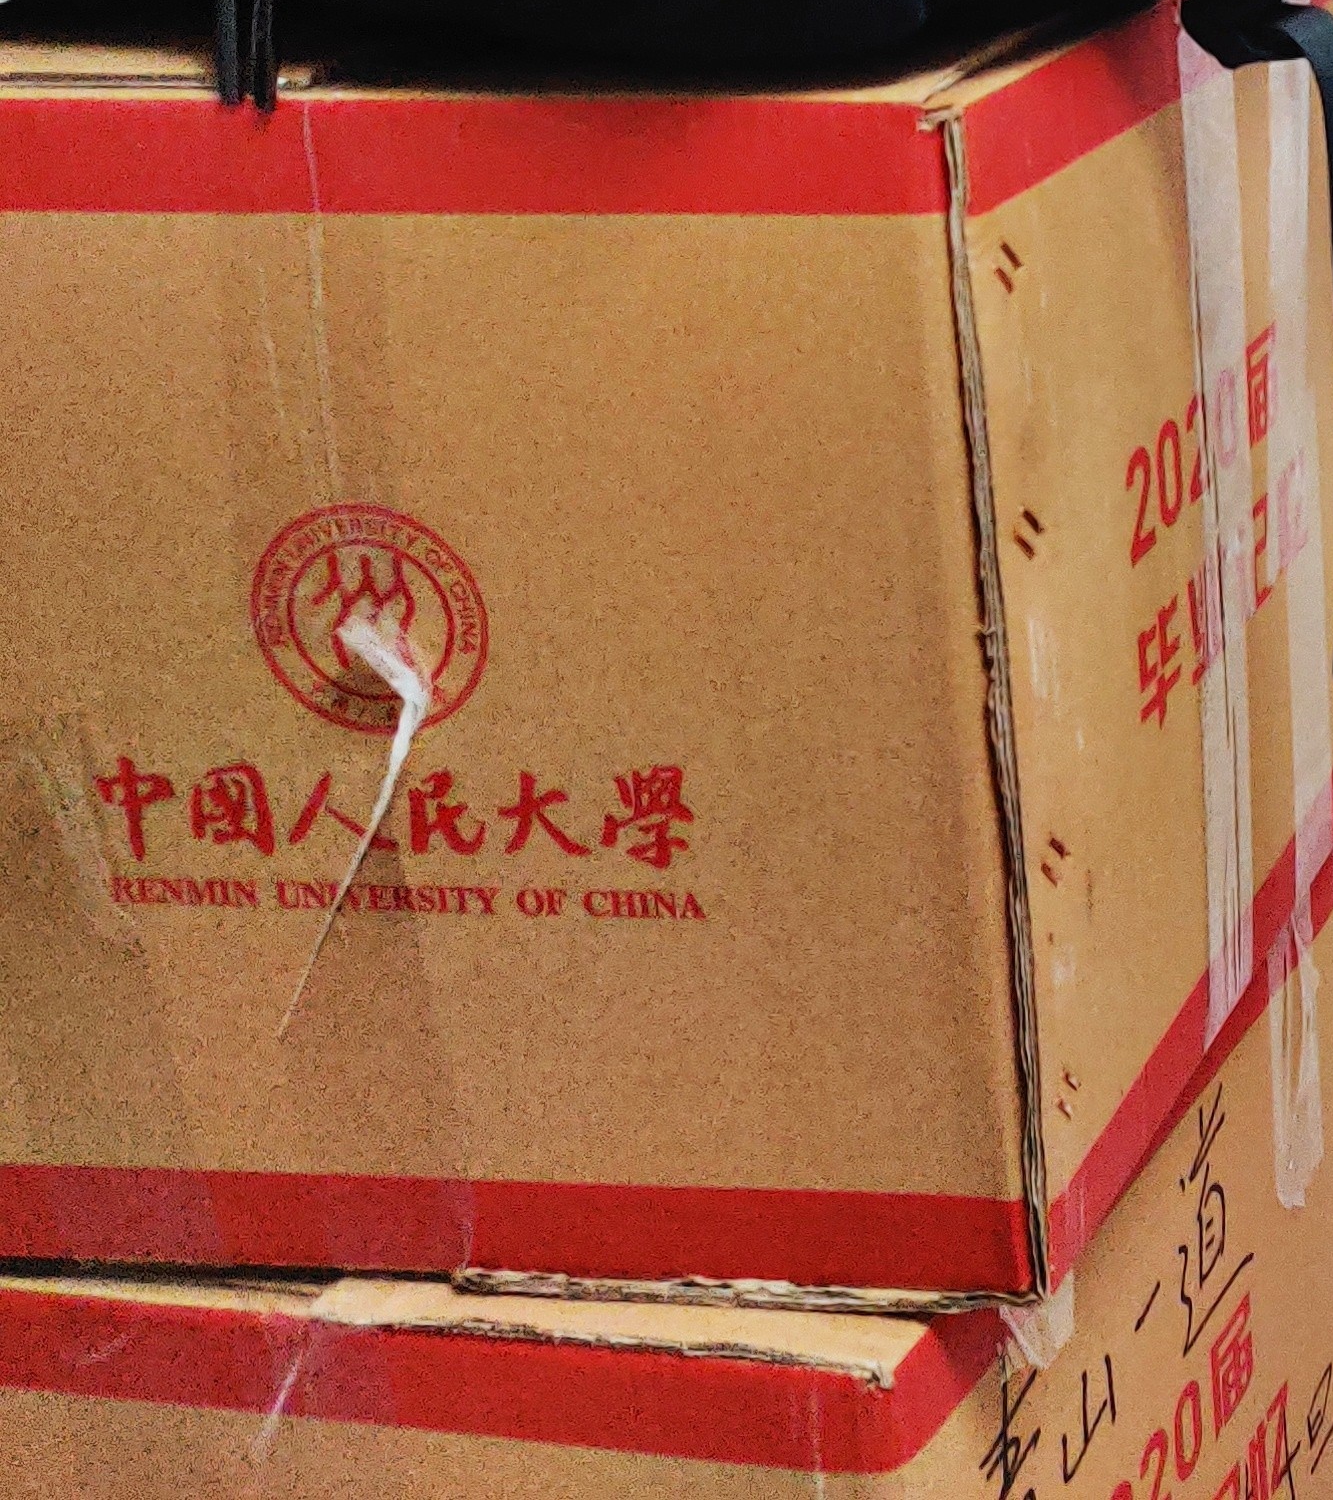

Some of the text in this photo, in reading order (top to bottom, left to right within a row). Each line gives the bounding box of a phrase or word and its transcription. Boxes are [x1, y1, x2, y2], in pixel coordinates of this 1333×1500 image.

[110, 877, 258, 906] RENMIN
[516, 888, 567, 917] OF
[582, 890, 707, 921] CHINA
